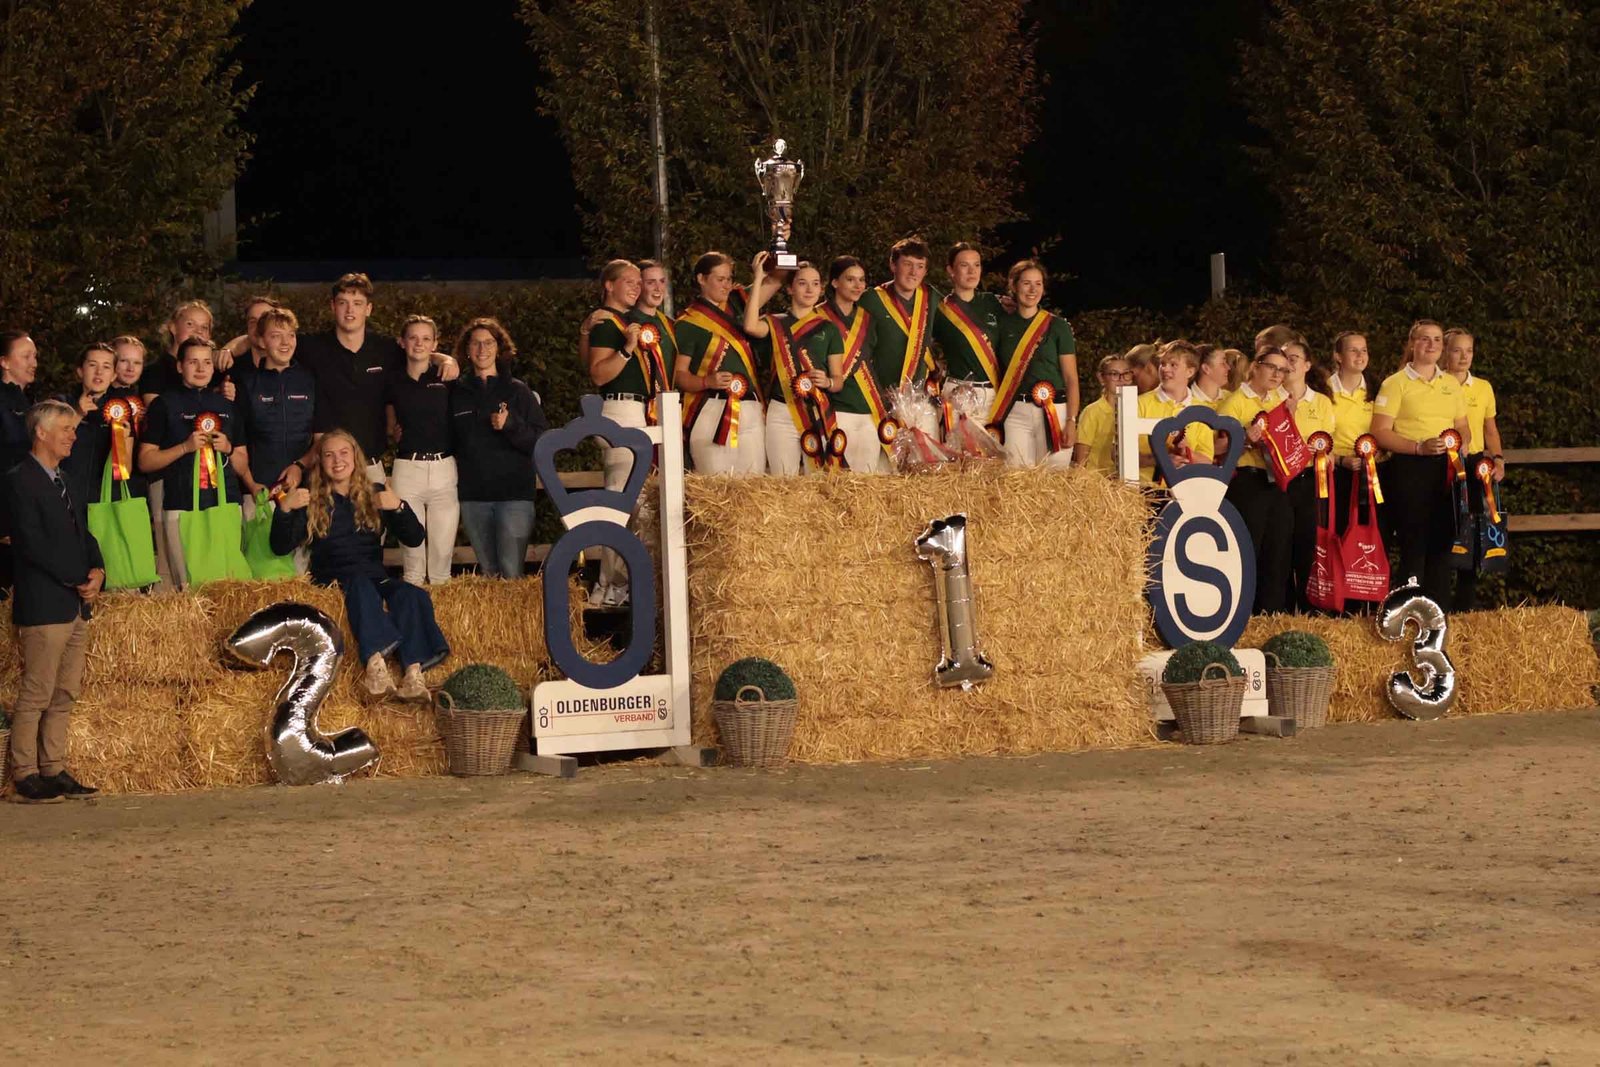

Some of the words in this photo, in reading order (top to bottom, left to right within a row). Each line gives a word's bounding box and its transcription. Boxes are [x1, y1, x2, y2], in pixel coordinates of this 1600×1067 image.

[914, 513, 993, 690] 1
[1174, 516, 1233, 633] S
[225, 600, 382, 786] 2
[557, 695, 652, 714] OLDENBURGER
[1375, 584, 1456, 721] 3
[614, 712, 653, 723] VERBAND
